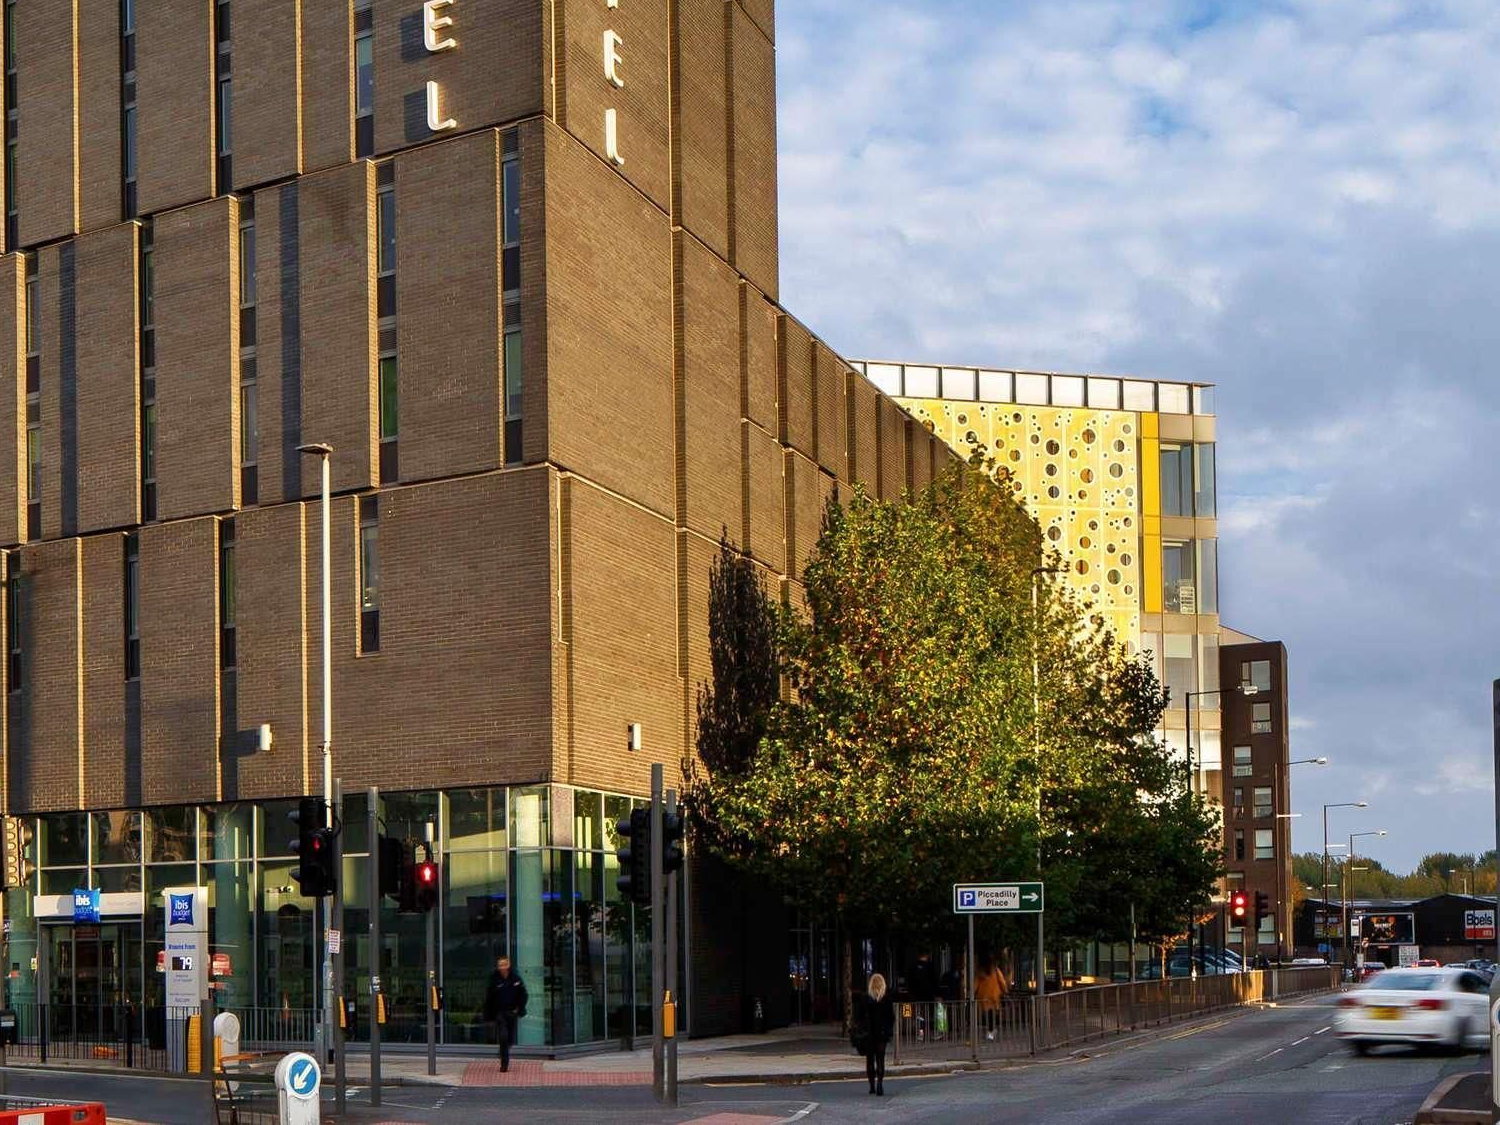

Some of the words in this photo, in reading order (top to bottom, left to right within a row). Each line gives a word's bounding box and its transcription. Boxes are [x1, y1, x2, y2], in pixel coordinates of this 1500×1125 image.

[75, 894, 91, 906] ibis
[977, 890, 1017, 899] Piccadilly
[174, 899, 189, 910] ibis
[986, 899, 1009, 907] Place
[1467, 912, 1492, 925] Boels
[180, 957, 193, 970] 79
